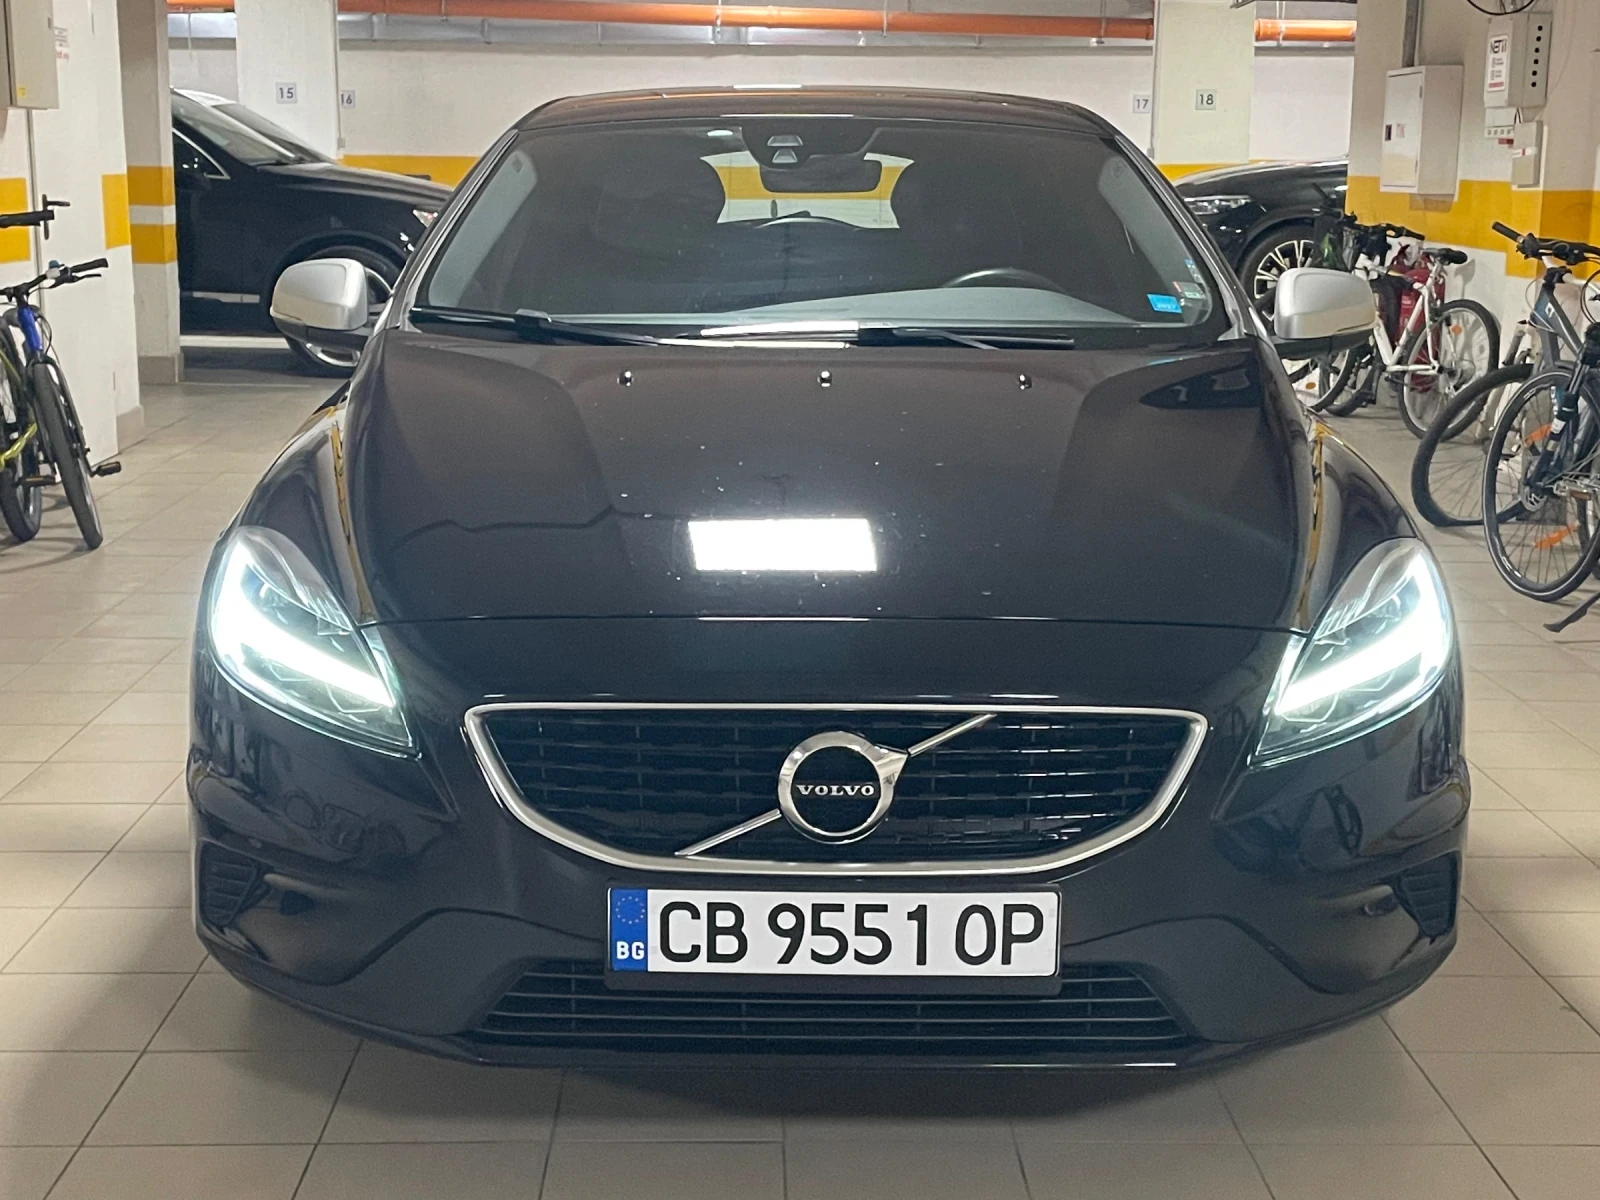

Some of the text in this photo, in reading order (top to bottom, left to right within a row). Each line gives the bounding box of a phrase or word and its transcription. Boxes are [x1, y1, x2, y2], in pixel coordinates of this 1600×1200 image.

[279, 87, 294, 99] 15
[341, 93, 353, 105] 16
[1199, 93, 1214, 106] 18
[1135, 98, 1149, 110] 17
[796, 784, 876, 797] VOLVO
[659, 901, 1044, 967] CB 9551 OP
[616, 940, 646, 960] BG
